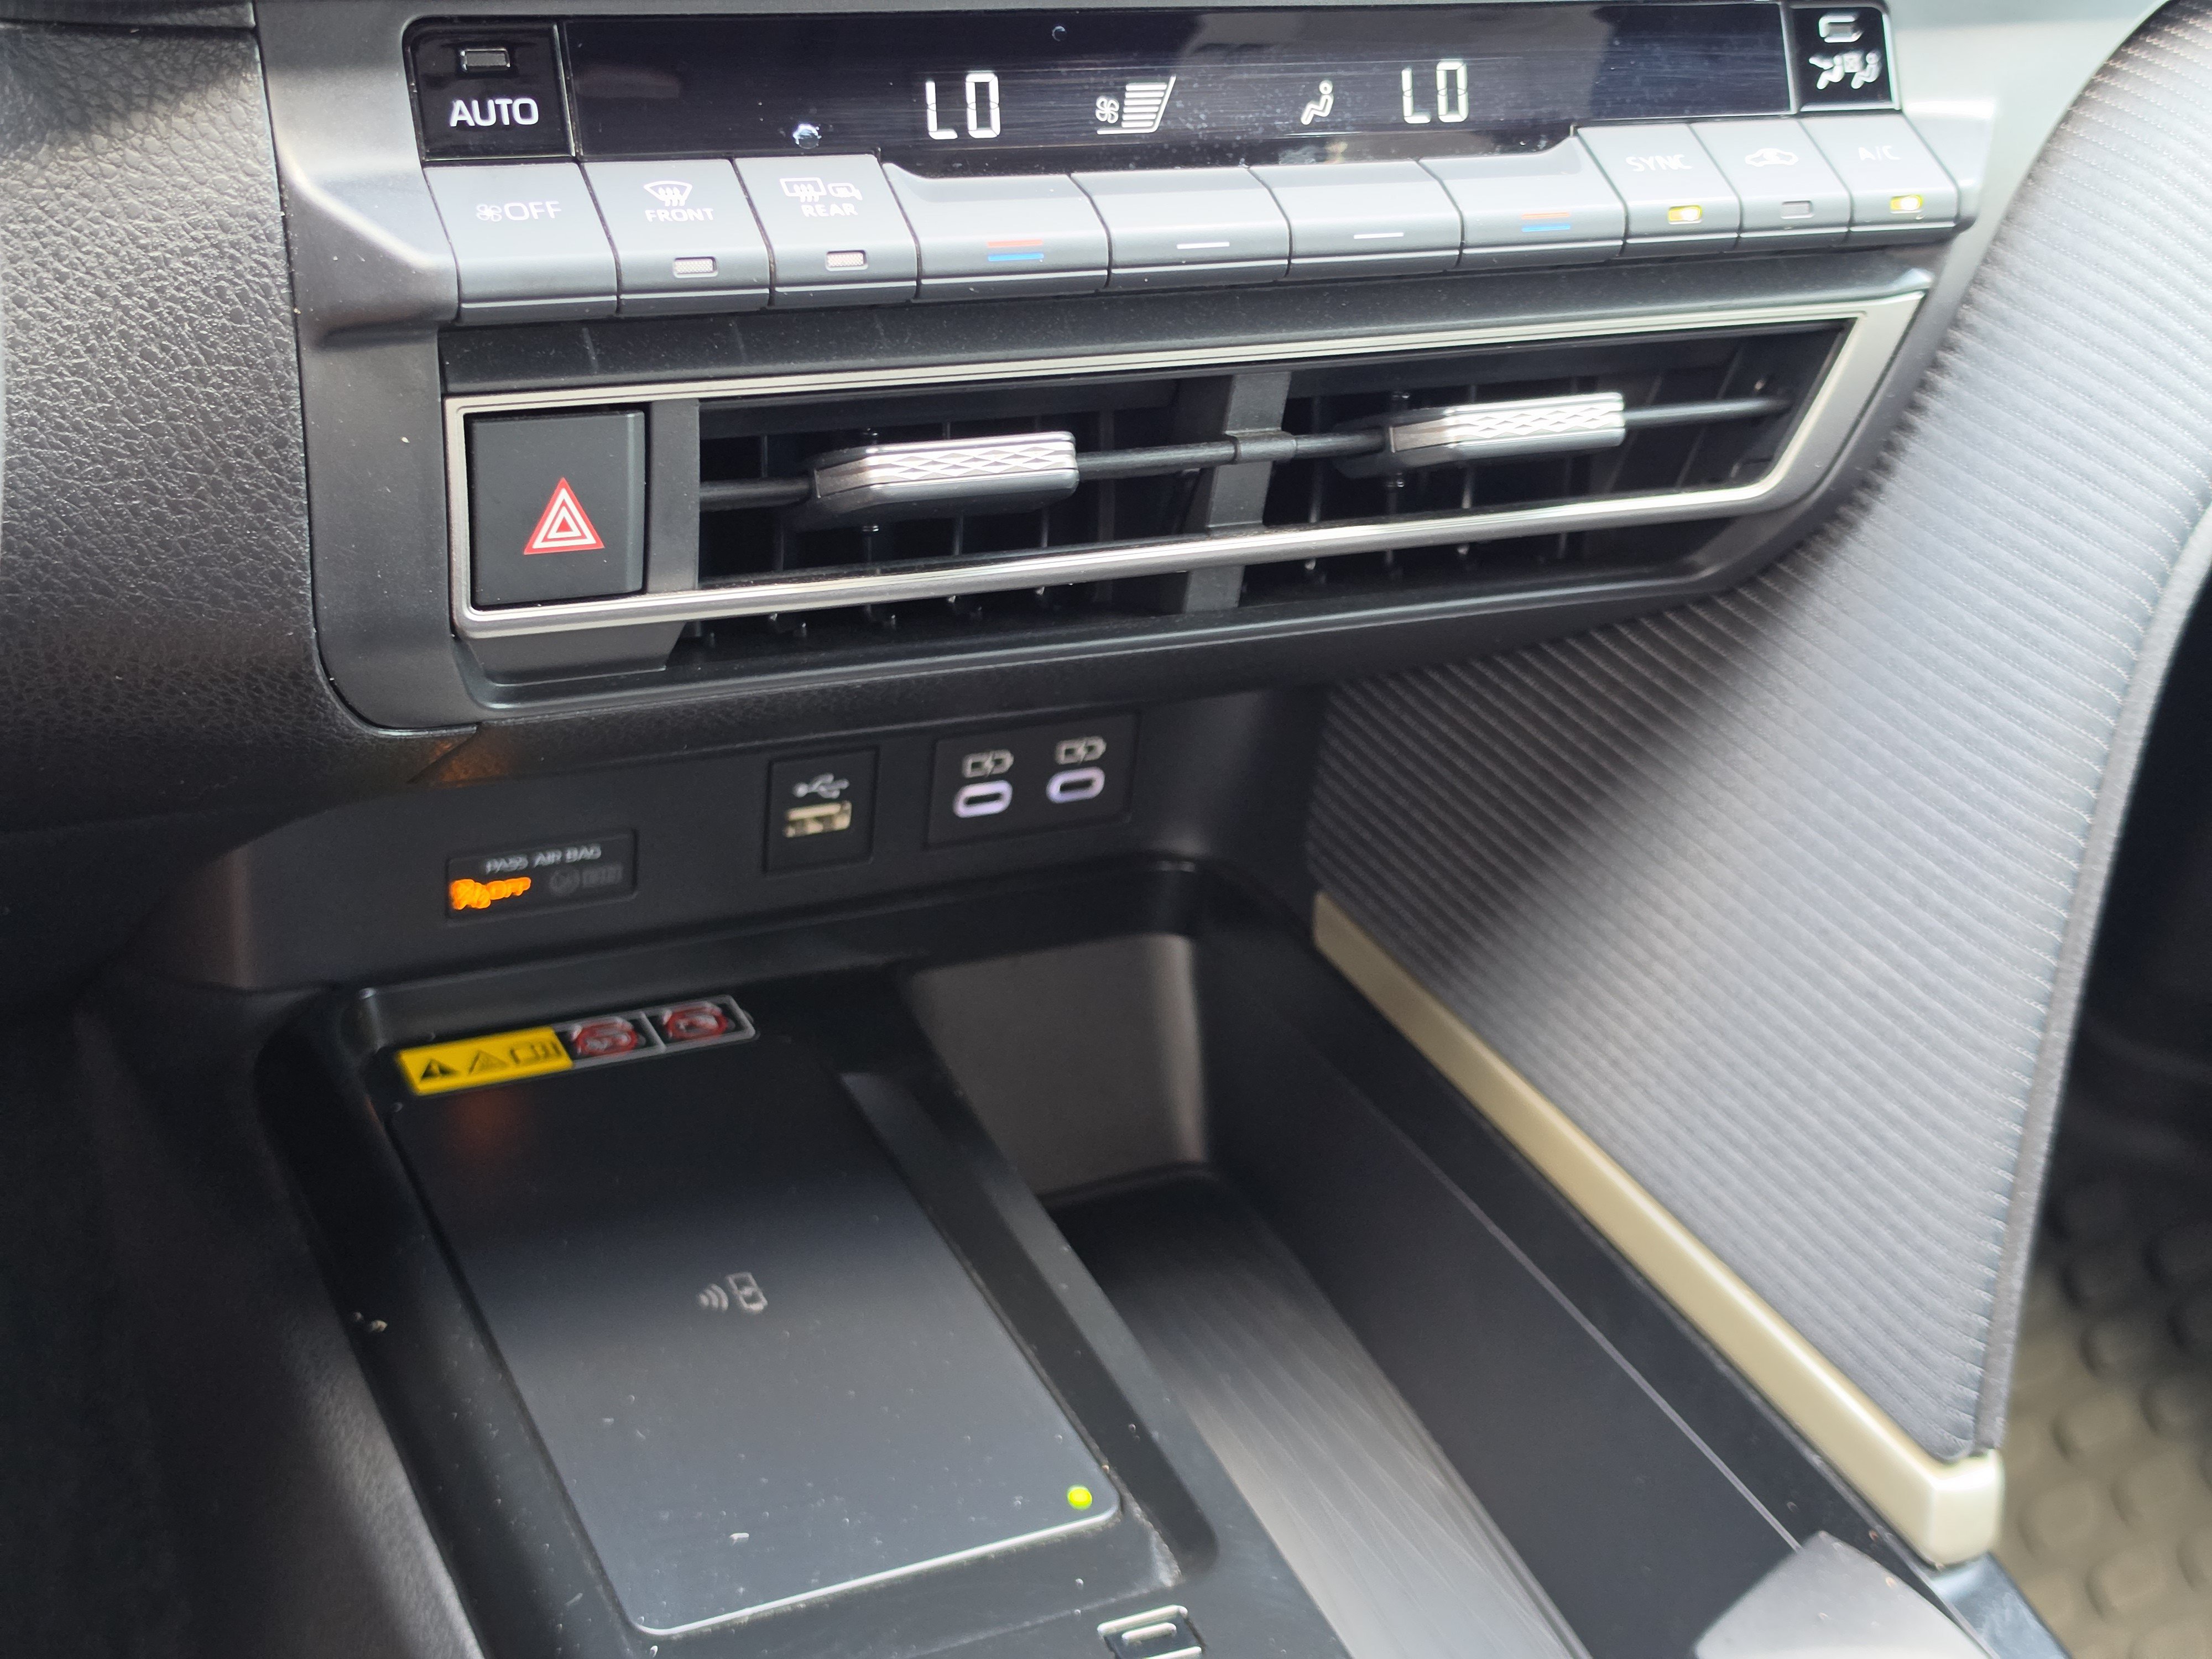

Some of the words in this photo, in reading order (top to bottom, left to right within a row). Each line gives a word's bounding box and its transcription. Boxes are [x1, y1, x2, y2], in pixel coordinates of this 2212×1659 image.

[450, 97, 539, 127] AUTO
[1858, 145, 1901, 161] A/C
[1626, 154, 1692, 172] SYNC
[504, 201, 562, 221] OFF
[645, 207, 714, 222] FRONT
[801, 204, 858, 217] REAR
